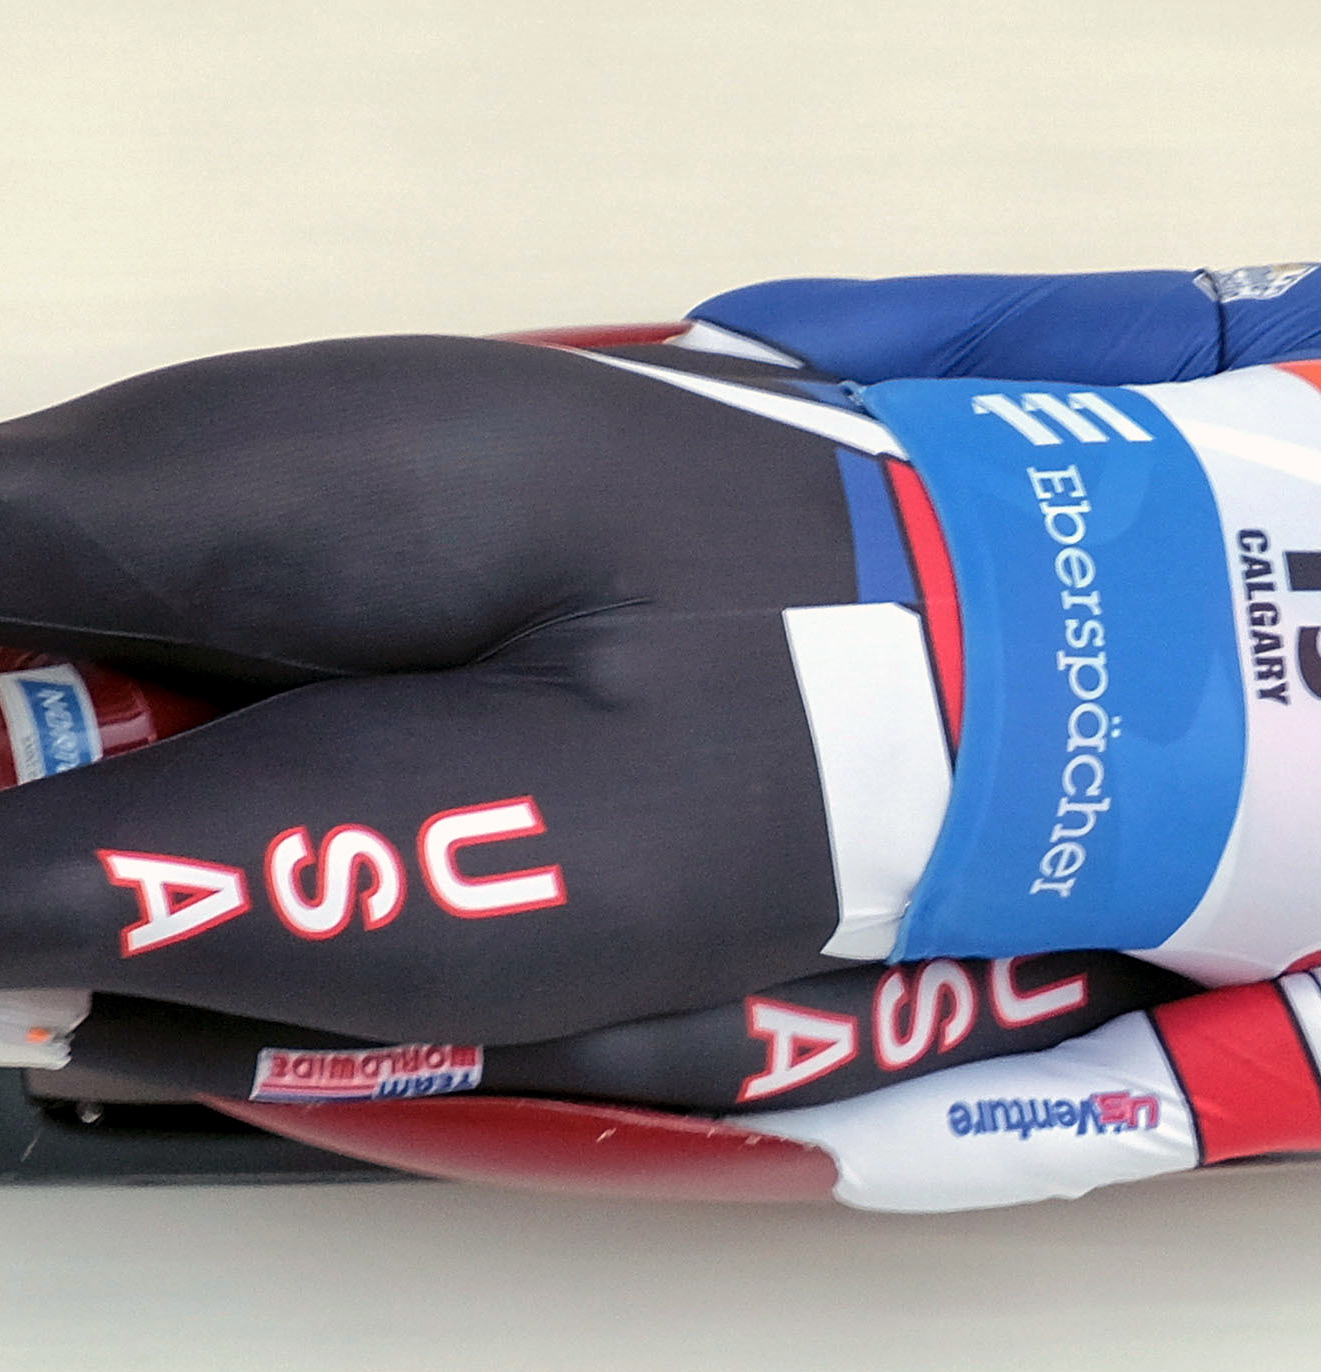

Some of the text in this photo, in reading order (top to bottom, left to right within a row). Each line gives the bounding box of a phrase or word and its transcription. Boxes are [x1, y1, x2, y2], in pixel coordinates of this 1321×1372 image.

[1027, 464, 1123, 897] Eberspächer
[1237, 529, 1291, 706] CALGARY
[96, 796, 567, 957] USA
